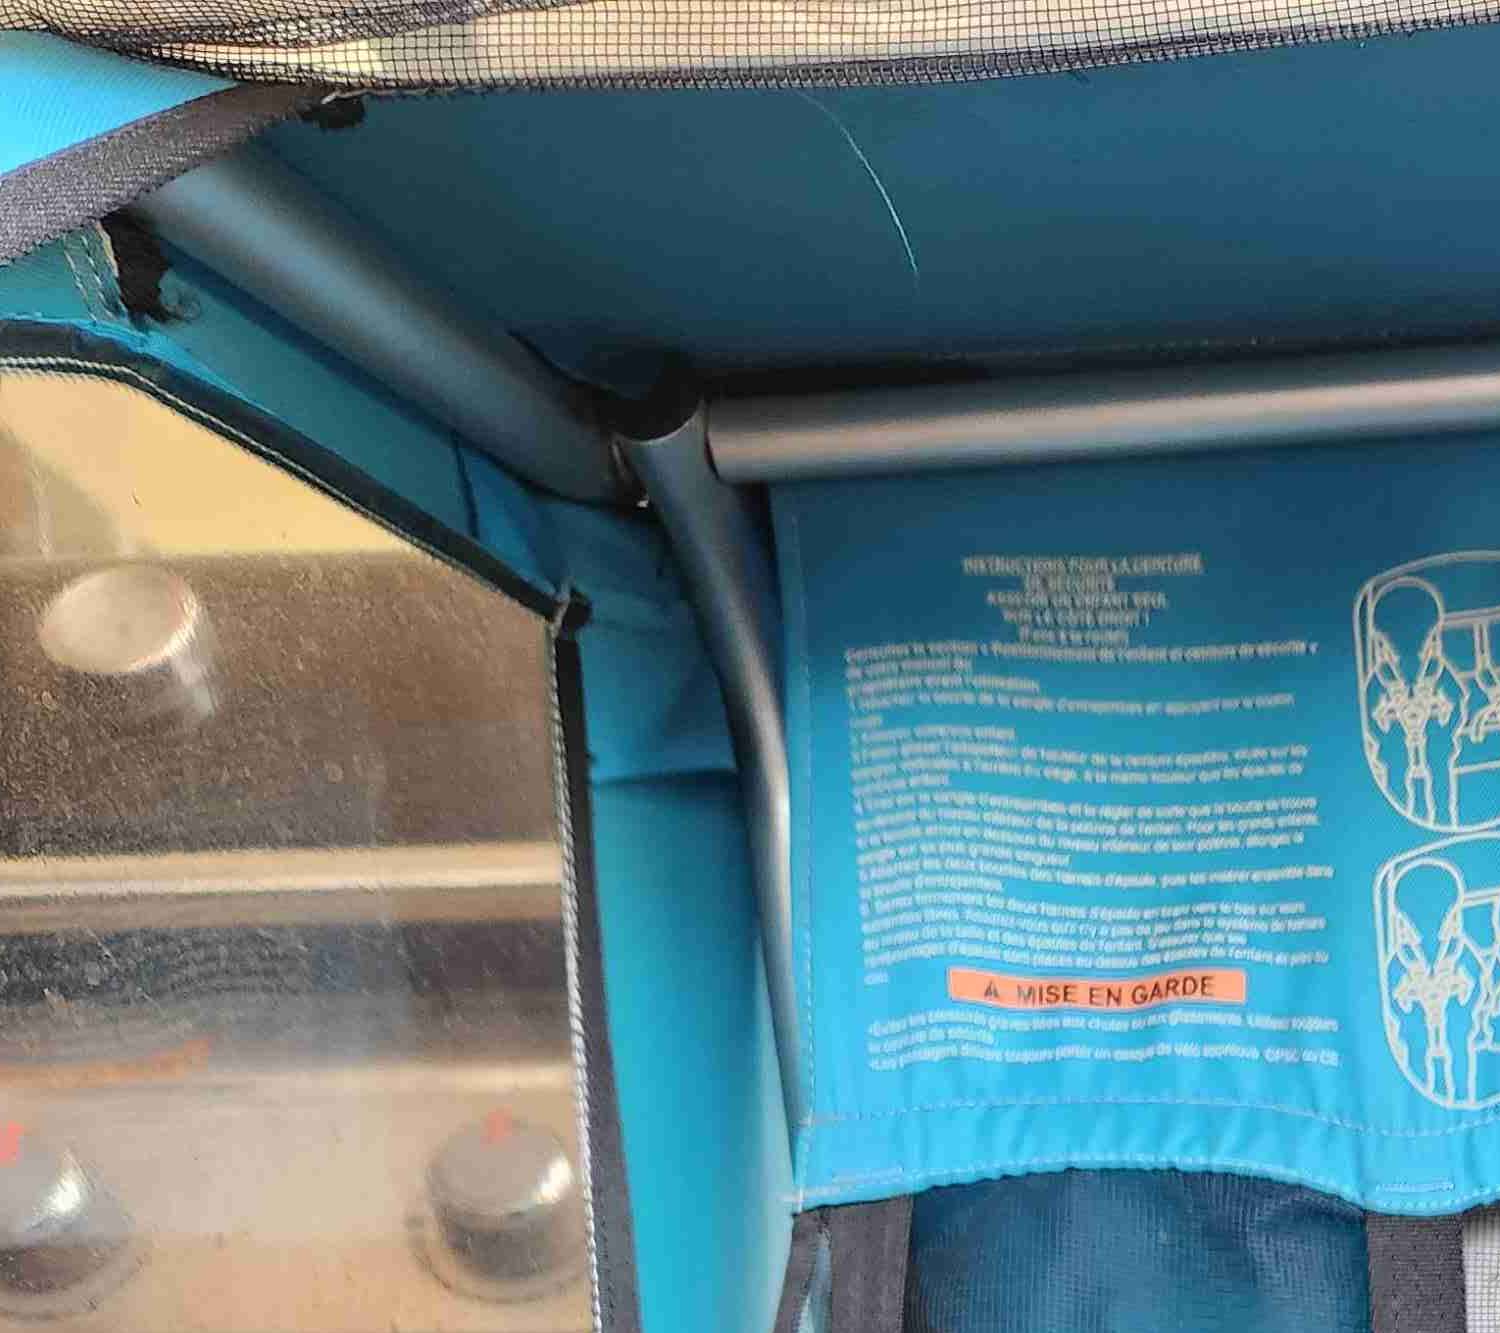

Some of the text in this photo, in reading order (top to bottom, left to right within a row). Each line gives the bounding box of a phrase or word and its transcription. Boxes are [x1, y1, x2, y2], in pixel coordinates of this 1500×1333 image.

[1017, 974, 1216, 1007] MISE EN GARDE
